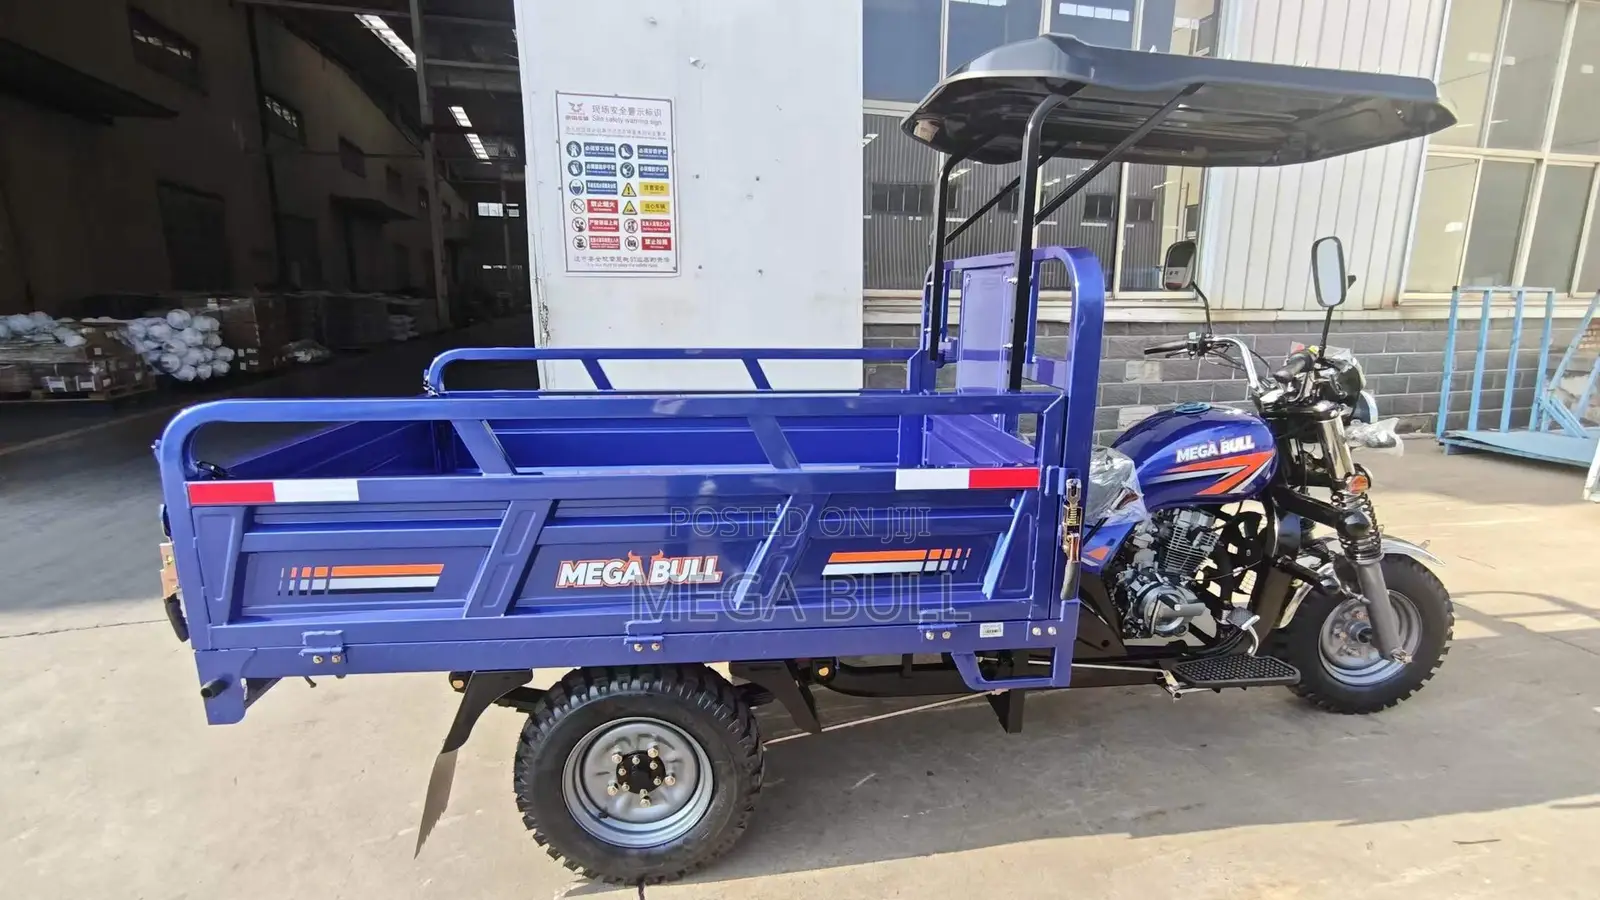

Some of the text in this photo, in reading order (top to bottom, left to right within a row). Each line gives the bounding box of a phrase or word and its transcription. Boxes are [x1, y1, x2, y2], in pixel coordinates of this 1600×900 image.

[592, 104, 662, 118] 现场安全警示标识
[605, 115, 623, 125] safety
[1175, 435, 1256, 463] MEGA BULL
[556, 555, 723, 588] MEGA BULL
